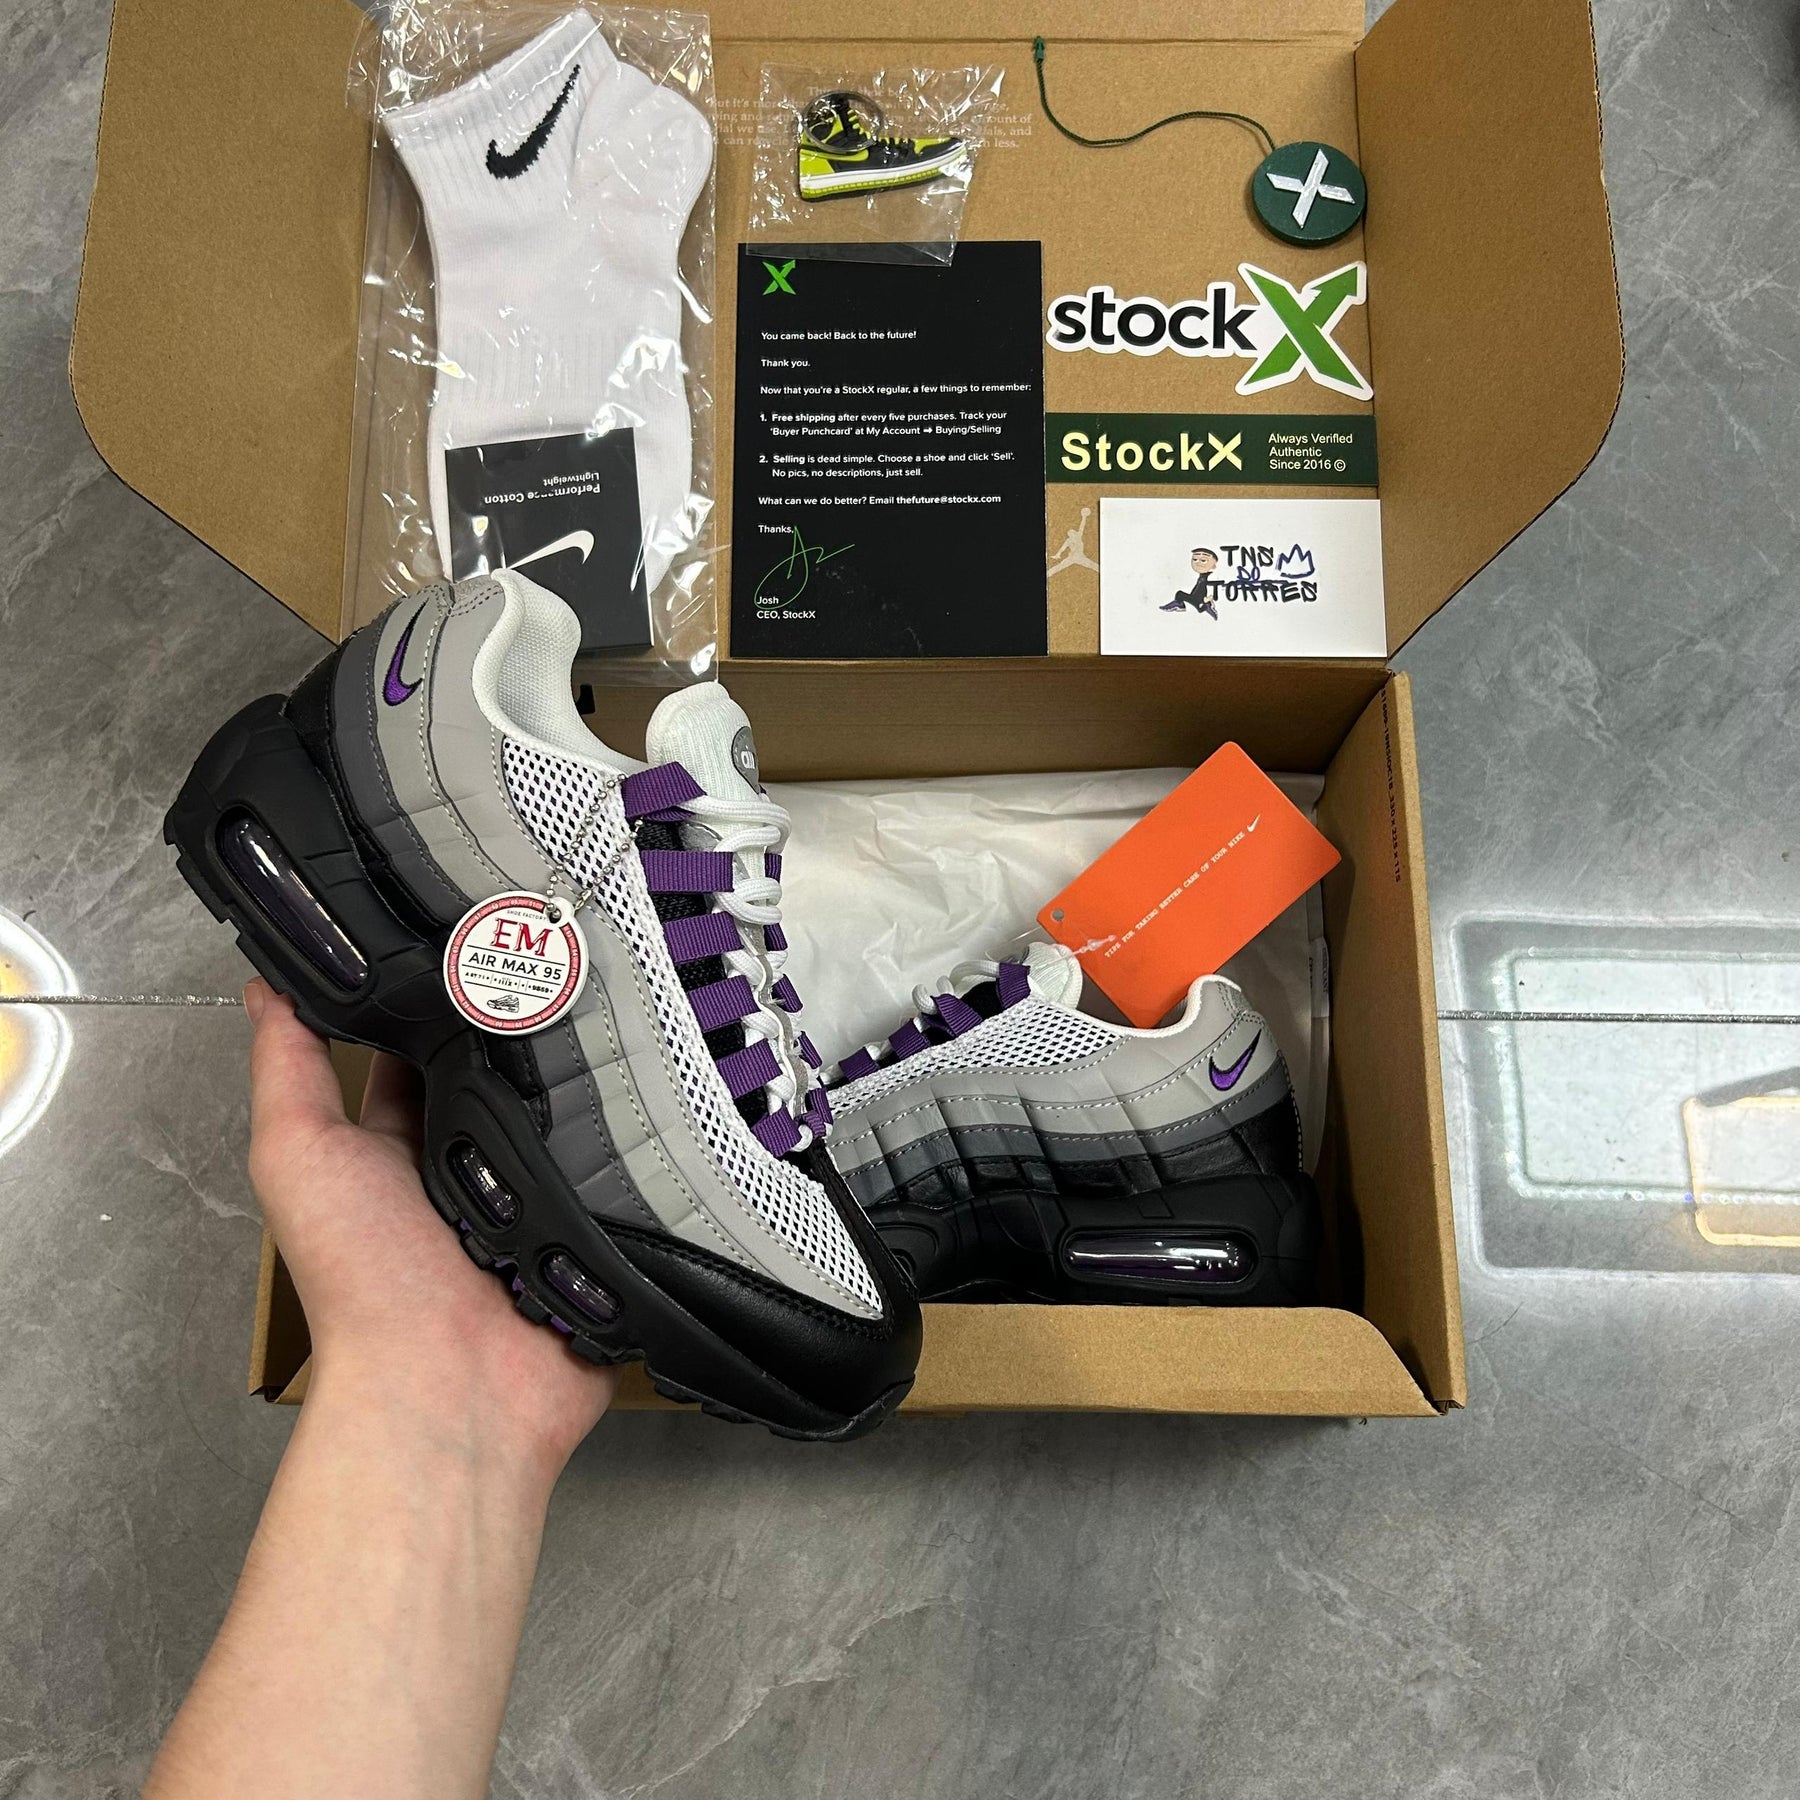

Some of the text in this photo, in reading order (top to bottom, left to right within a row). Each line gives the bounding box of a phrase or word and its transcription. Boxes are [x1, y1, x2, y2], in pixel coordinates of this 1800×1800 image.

[1020, 113, 1032, 123] of
[737, 125, 754, 133] we
[1010, 126, 1032, 136] and
[994, 138, 1020, 148] less.
[761, 332, 779, 341] You
[807, 331, 832, 340] back!
[833, 331, 857, 340] Back
[858, 332, 869, 340] to
[869, 331, 885, 340] the
[886, 330, 917, 339] future!
[760, 358, 811, 369] Thank you.
[760, 385, 782, 395] Now
[783, 386, 802, 395] that
[842, 385, 875, 394] StockX
[876, 385, 911, 396] regular,
[912, 386, 919, 394] a
[920, 384, 939, 393] few
[939, 384, 969, 394] things
[969, 384, 980, 392] to
[981, 383, 1032, 392] remember:
[759, 411, 1007, 424] 1. Free shipping after every five purchases. Track your
[854, 427, 865, 435] at
[865, 426, 881, 437] My
[881, 426, 921, 435] Account
[1268, 433, 1353, 446] Always Verified
[1061, 431, 1242, 472] StockX
[1269, 446, 1322, 457] Authentic
[759, 454, 769, 463] 2.
[773, 454, 806, 465] Selling
[807, 455, 816, 464] is
[817, 454, 841, 464] dead
[842, 454, 876, 465] simple.
[877, 454, 914, 463] Choose
[915, 455, 922, 463] a
[923, 453, 947, 462] shoe
[947, 453, 966, 462] and
[967, 453, 989, 461] click
[1269, 460, 1301, 470] Since
[1303, 460, 1332, 470] 2016
[772, 468, 787, 477] No
[787, 469, 810, 479] pics,
[825, 468, 885, 479] descriptions,
[885, 468, 903, 479] just
[904, 467, 923, 477] sell.
[542, 472, 600, 487] Lightweight
[484, 492, 525, 504] Cotton
[758, 496, 783, 505] What
[819, 496, 833, 505] do
[834, 496, 867, 505] better?
[869, 496, 895, 505] Email
[895, 495, 1002, 505] thefuture@stockx.com
[757, 524, 794, 534] Thanks,
[1220, 545, 1274, 568] TNS
[756, 595, 779, 605] Josh
[756, 610, 816, 620] CEO, StockX
[1104, 942, 1122, 958] TIPS
[1122, 930, 1135, 944] FOR
[1135, 908, 1159, 930] TAKING
[1160, 888, 1183, 910] BETTER
[1183, 872, 1201, 888] CARE
[1210, 847, 1228, 864] YOUR
[1228, 831, 1246, 848] NIKE
[490, 917, 553, 957] EM
[468, 952, 496, 968] AIR
[501, 958, 538, 976] MAX
[543, 966, 563, 980] 95
